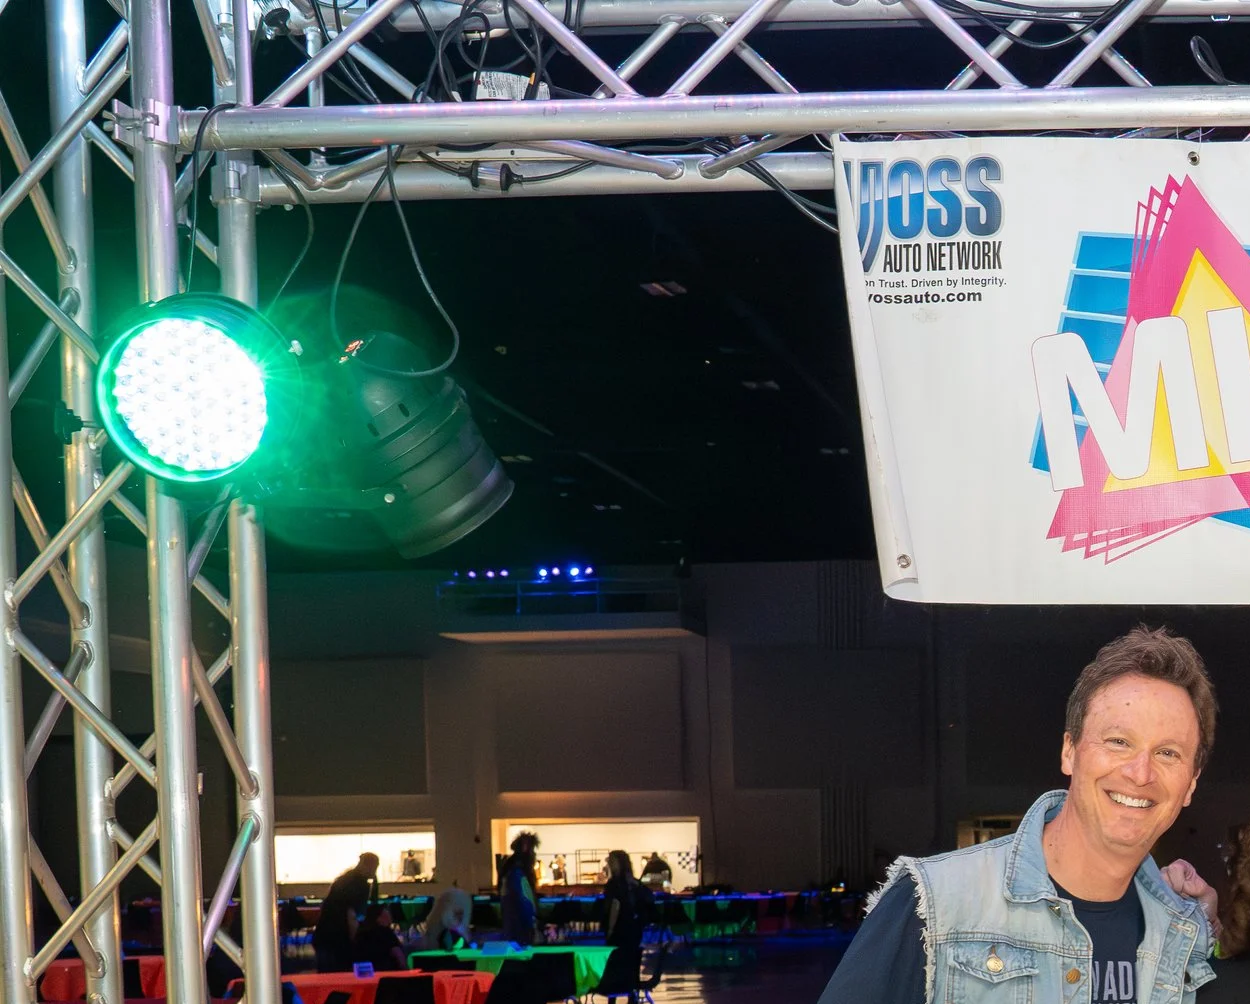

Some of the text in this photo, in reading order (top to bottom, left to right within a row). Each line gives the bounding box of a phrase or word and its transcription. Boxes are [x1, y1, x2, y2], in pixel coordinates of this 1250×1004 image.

[883, 241, 1002, 273] AUTO NETWORK
[879, 279, 908, 288] Trust.
[912, 278, 943, 288] Driven
[946, 277, 958, 288] by
[961, 276, 1007, 288] Integrity.
